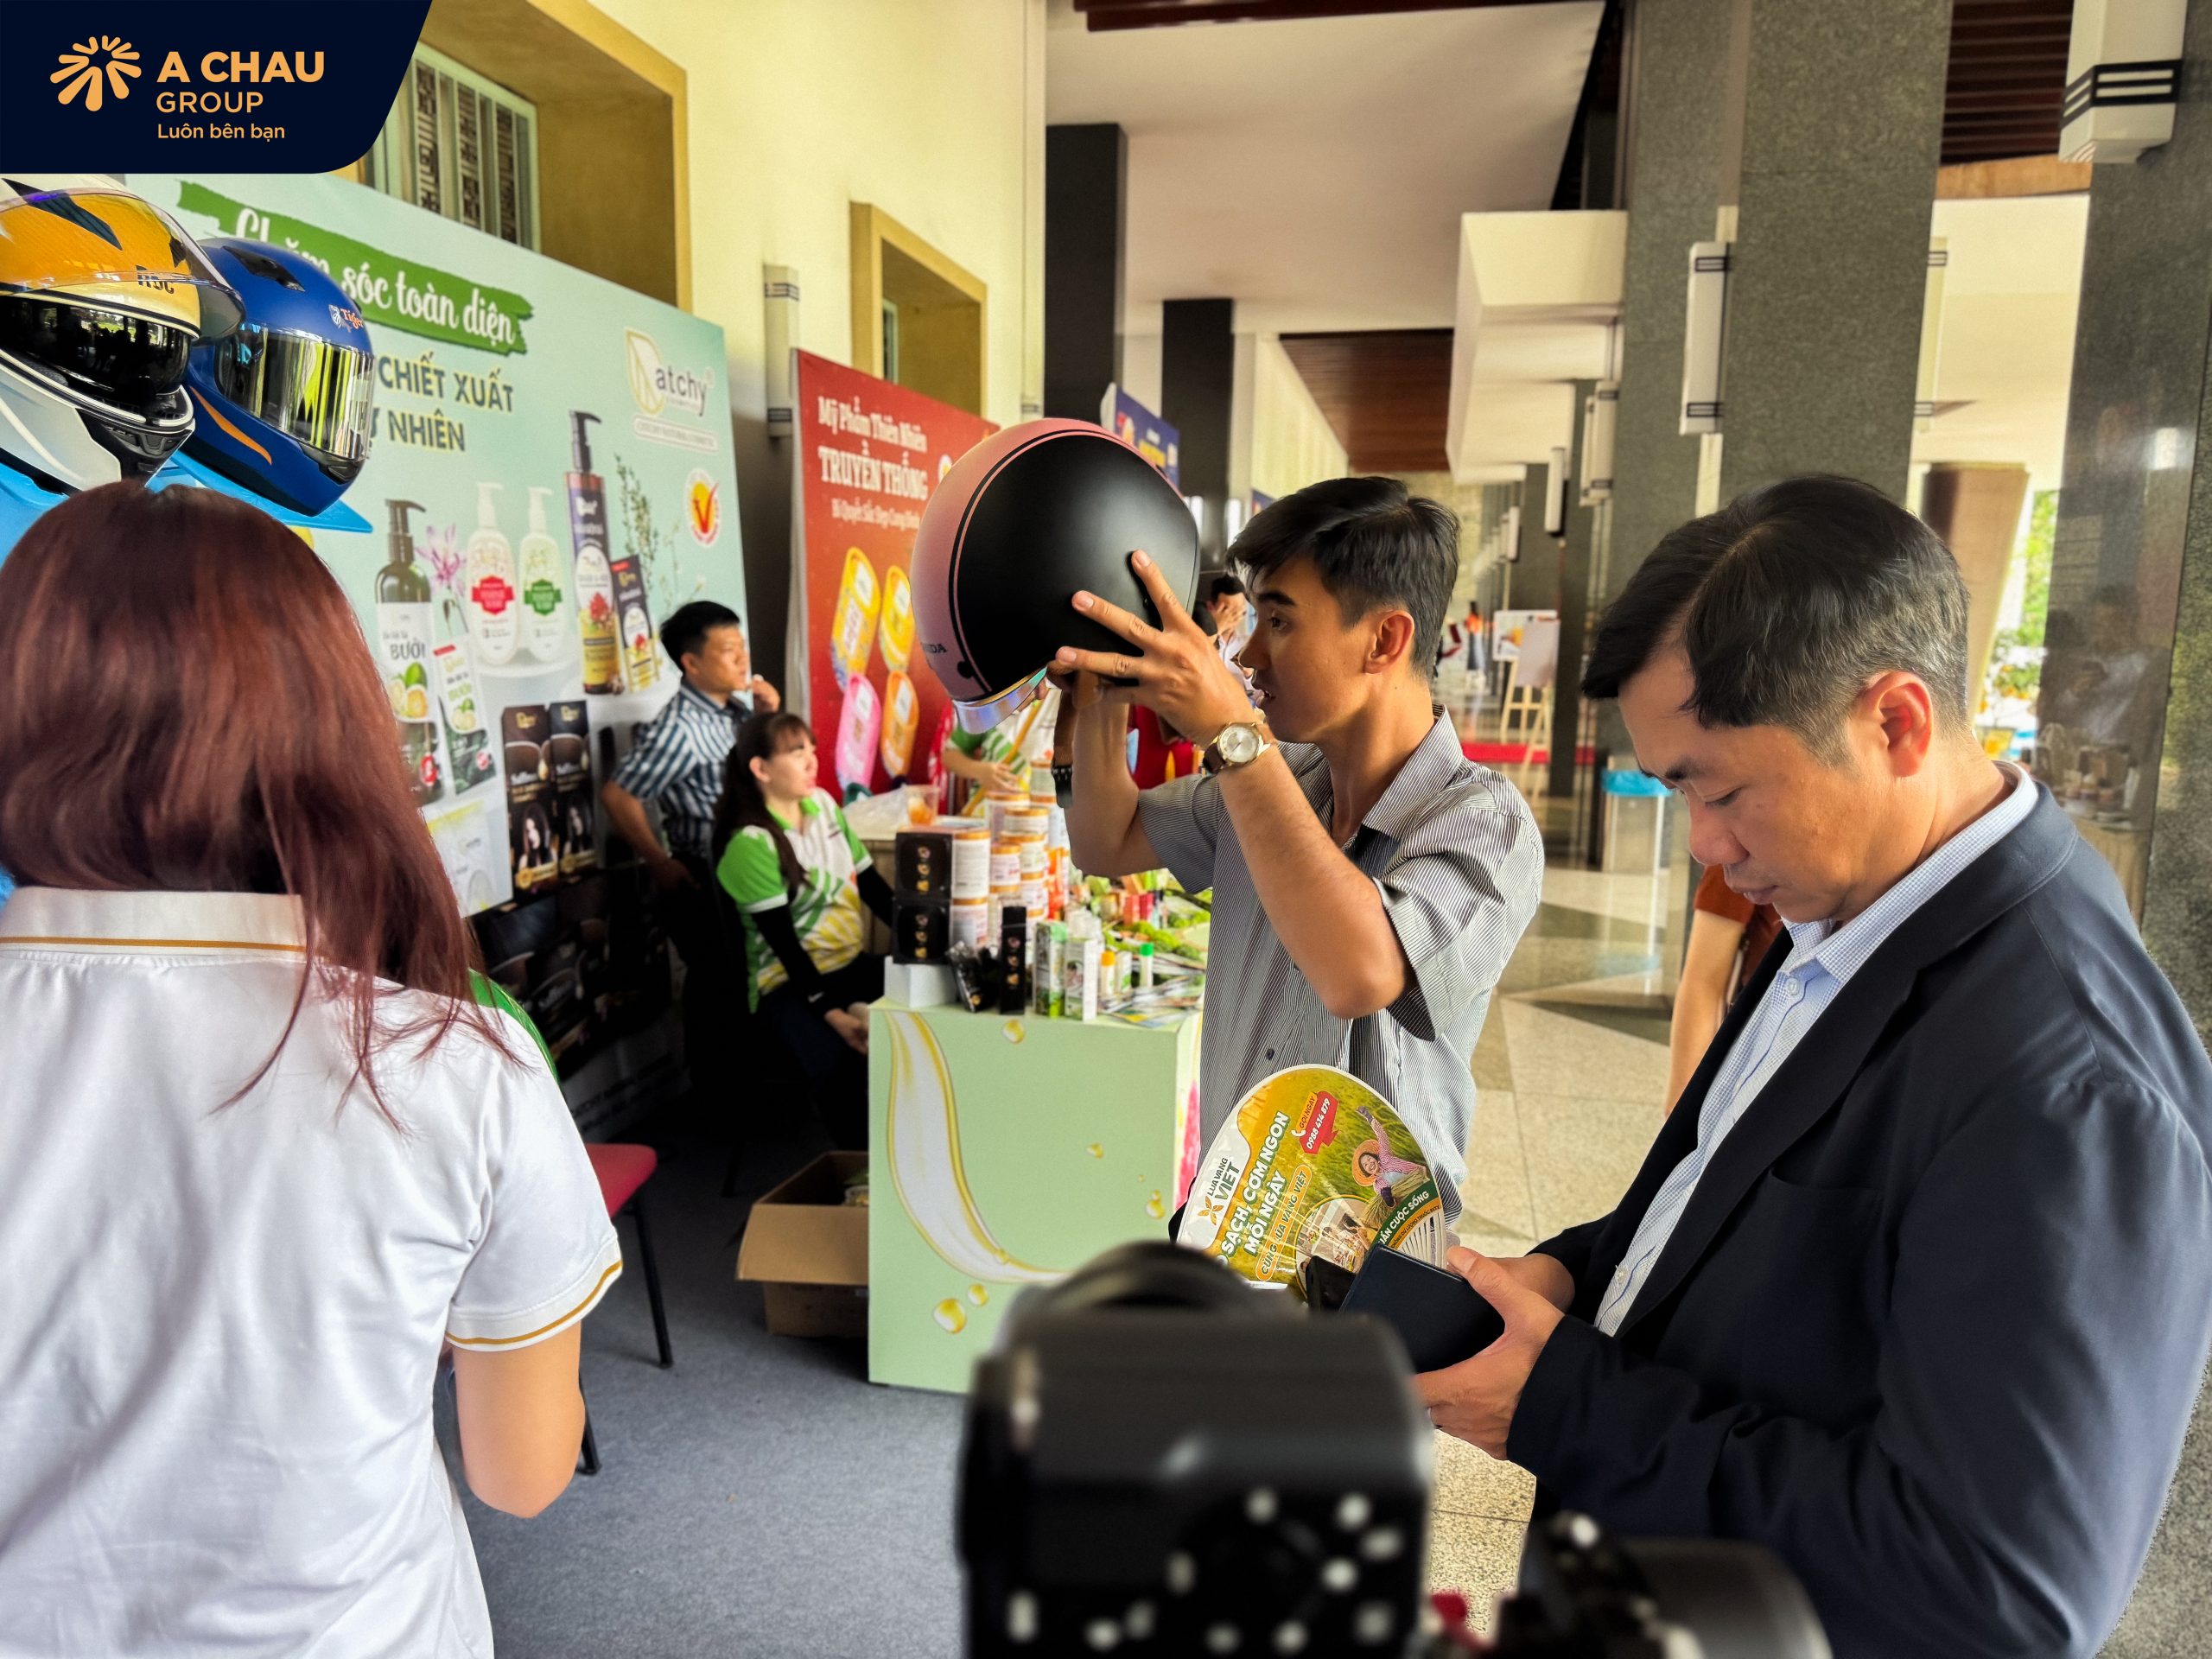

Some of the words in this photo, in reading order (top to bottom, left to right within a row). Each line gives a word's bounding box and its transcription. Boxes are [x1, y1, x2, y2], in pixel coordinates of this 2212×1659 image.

[341, 262, 392, 309] sóc
[396, 270, 461, 330] toàn
[462, 288, 517, 346] diện
[378, 350, 446, 399] CHIẾT
[454, 367, 514, 413] XUẤT
[387, 408, 467, 452] NHIÊN
[817, 395, 838, 435] Mỹ
[838, 395, 872, 438] Phẩm
[869, 412, 899, 446] Thiên
[899, 422, 928, 454] Nhiên
[817, 438, 882, 493] TRUYỀN
[881, 450, 929, 502] THỐNG
[1306, 1096, 1315, 1116] NGAY
[1306, 1127, 1319, 1149] 0988
[1315, 1114, 1325, 1128] 414
[1320, 1097, 1331, 1115] 879
[1207, 1180, 1218, 1197] LUA
[1214, 1158, 1228, 1180] VANG
[1215, 1161, 1239, 1199] VIET
[1243, 1160, 1268, 1202] CƠM
[1260, 1111, 1288, 1163] NGON
[1244, 1216, 1268, 1255] MỖI
[1258, 1169, 1287, 1220] NGÀY
[1261, 1243, 1277, 1274] CÙNG
[1281, 1194, 1298, 1223] VÀNG
[1294, 1170, 1308, 1193] VIỆT
[1389, 1207, 1409, 1230] CUỘC
[1408, 1191, 1430, 1211] SỐNG
